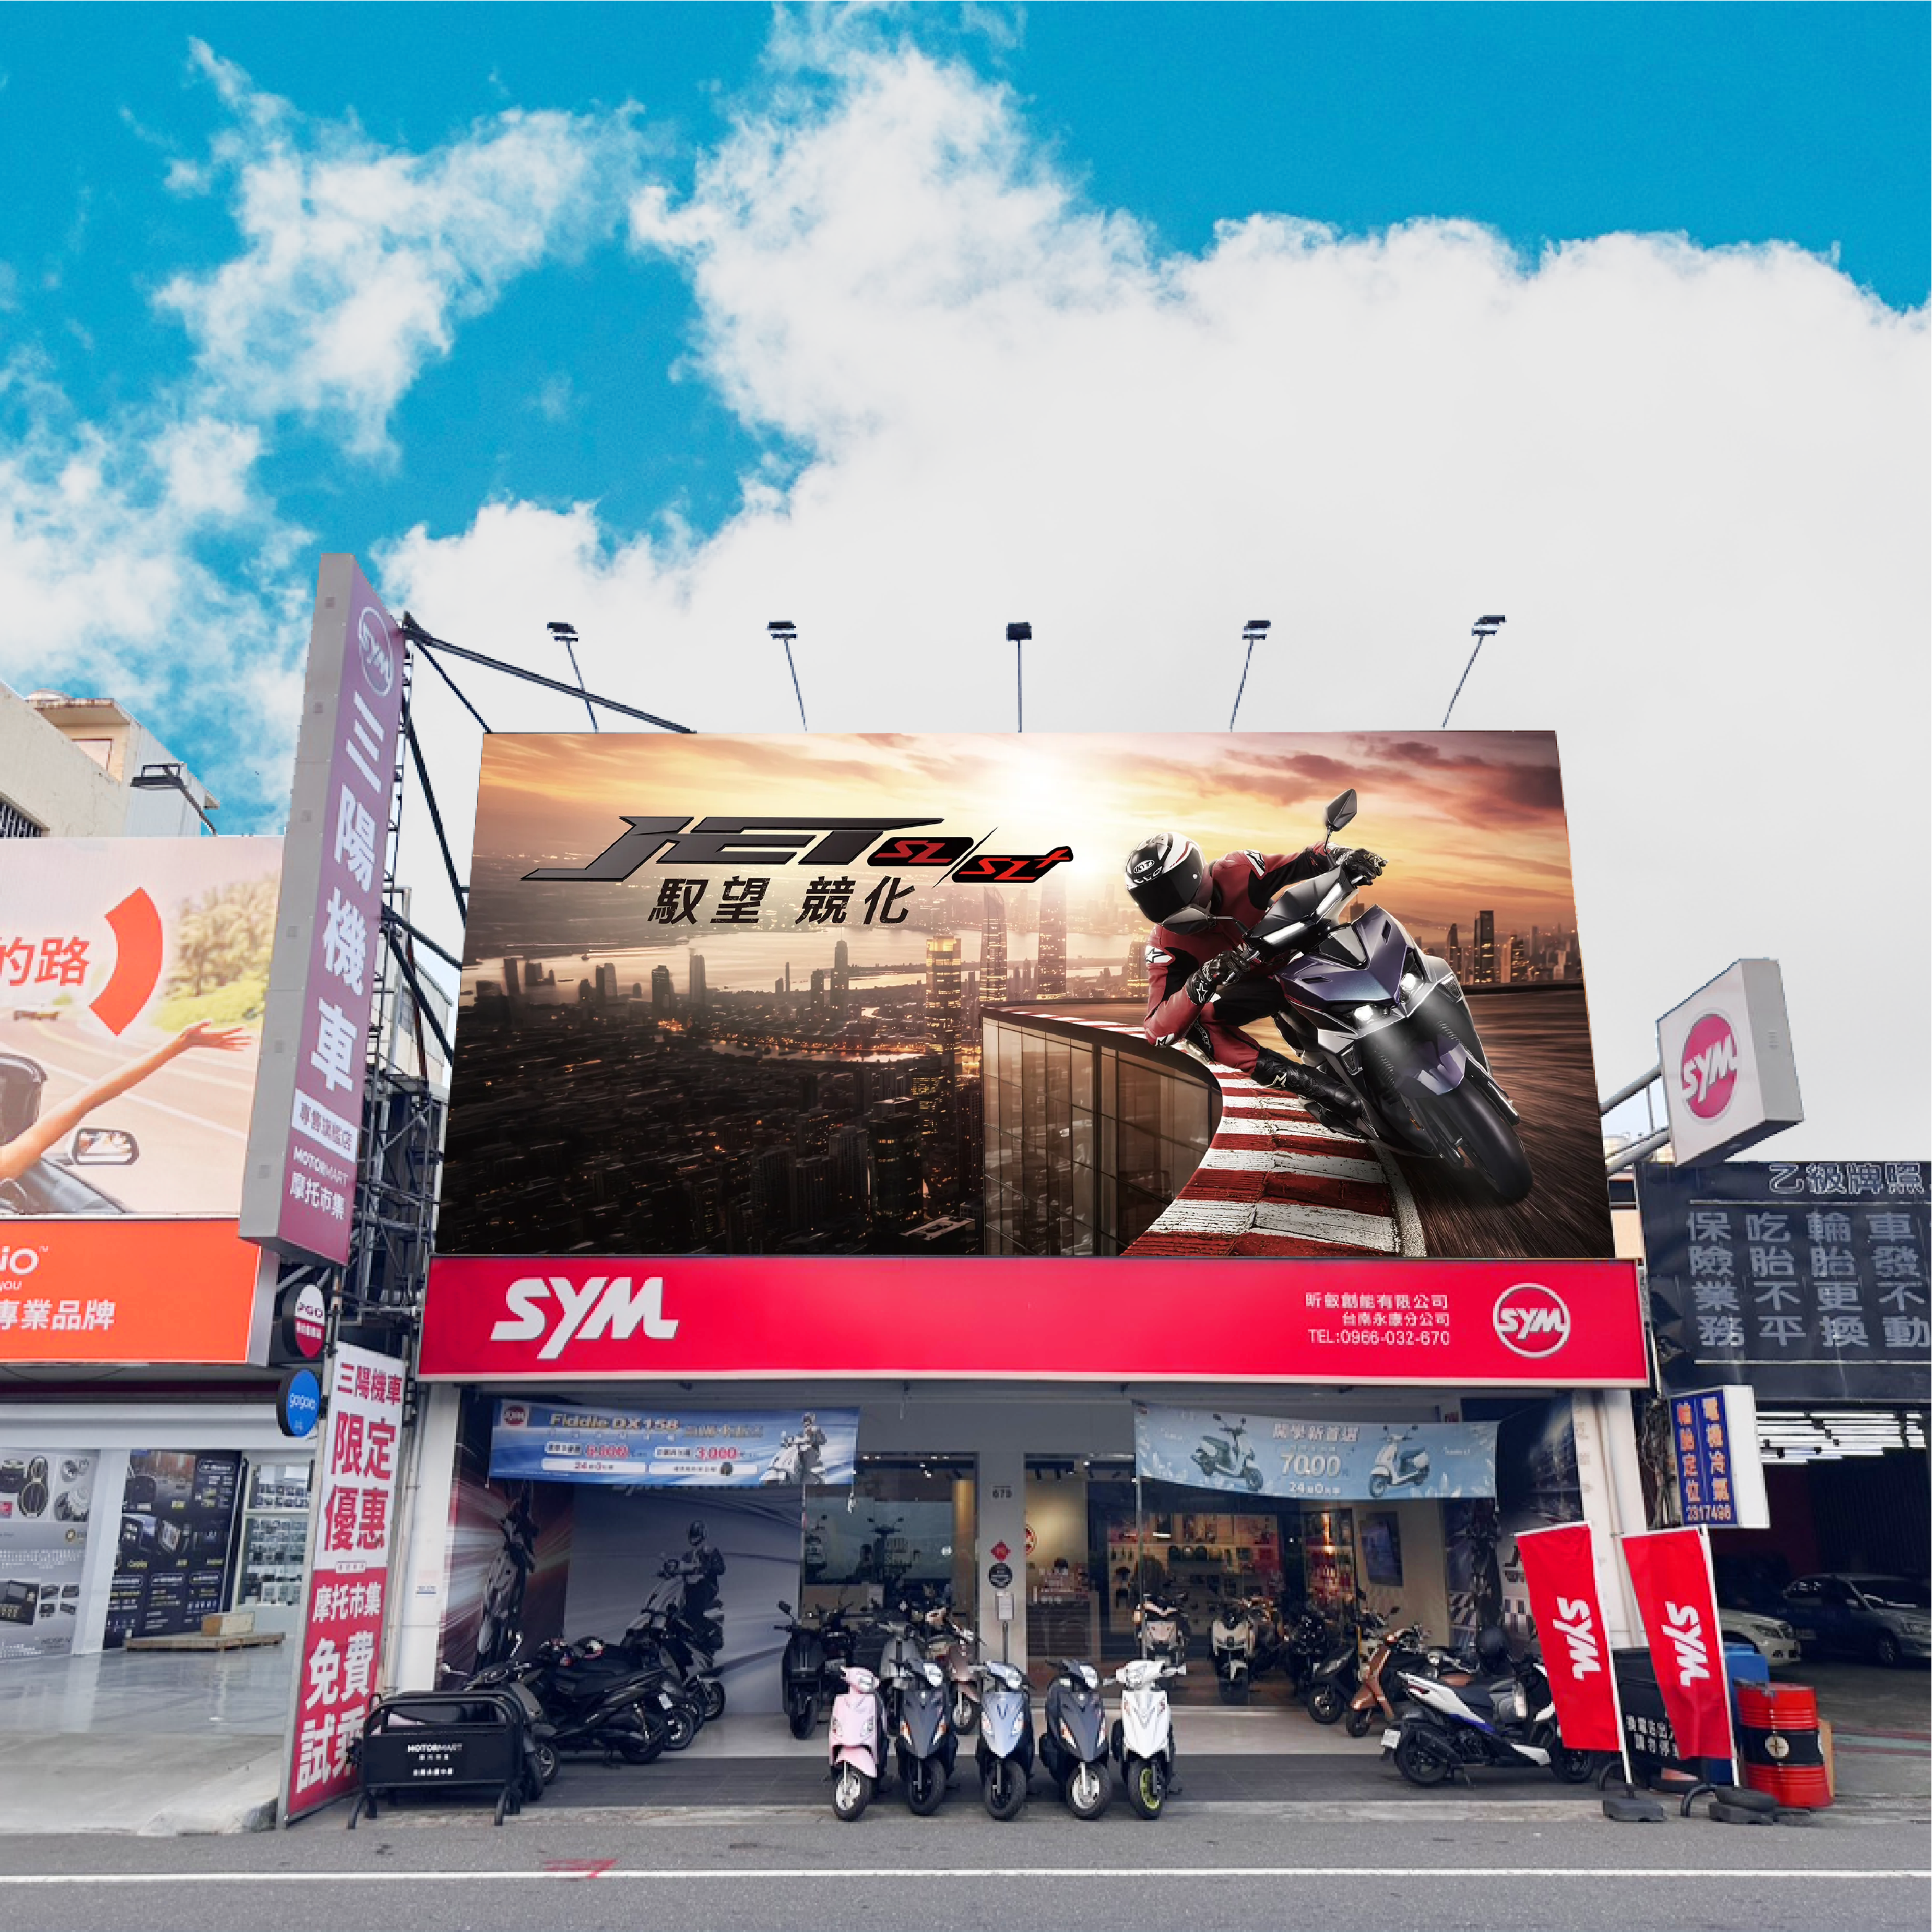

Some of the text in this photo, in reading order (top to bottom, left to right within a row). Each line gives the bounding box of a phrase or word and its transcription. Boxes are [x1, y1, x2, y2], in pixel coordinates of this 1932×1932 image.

[360, 621, 392, 678] SYM
[520, 816, 944, 882] JET
[310, 689, 384, 1091] 三陽機車
[1681, 1033, 1738, 1104] SYM
[289, 1171, 344, 1220] 摩托市集
[293, 1146, 349, 1187] MOTORMART
[1686, 1211, 1745, 1347] 保險業務
[1745, 1211, 1807, 1347] 吃胎不平
[1805, 1210, 1870, 1347] 輪胎更換
[1865, 1211, 1931, 1347] 車發不動
[490, 1276, 679, 1359] SYM
[1307, 1329, 1450, 1346] TEL:0966-032-670
[1342, 1311, 1449, 1328] 台南永康分公司
[289, 1392, 316, 1410] gogoro
[337, 1362, 402, 1405] 三陽機車
[331, 1410, 397, 1481] 限定
[550, 1413, 609, 1429] Fiddle
[324, 1483, 389, 1552] 優惠
[312, 1581, 381, 1624] 摩托市集
[305, 1630, 374, 1711] 免費
[1553, 1595, 1602, 1682] SYM
[1661, 1601, 1710, 1687] SYM
[407, 1742, 463, 1753] MOTORMART
